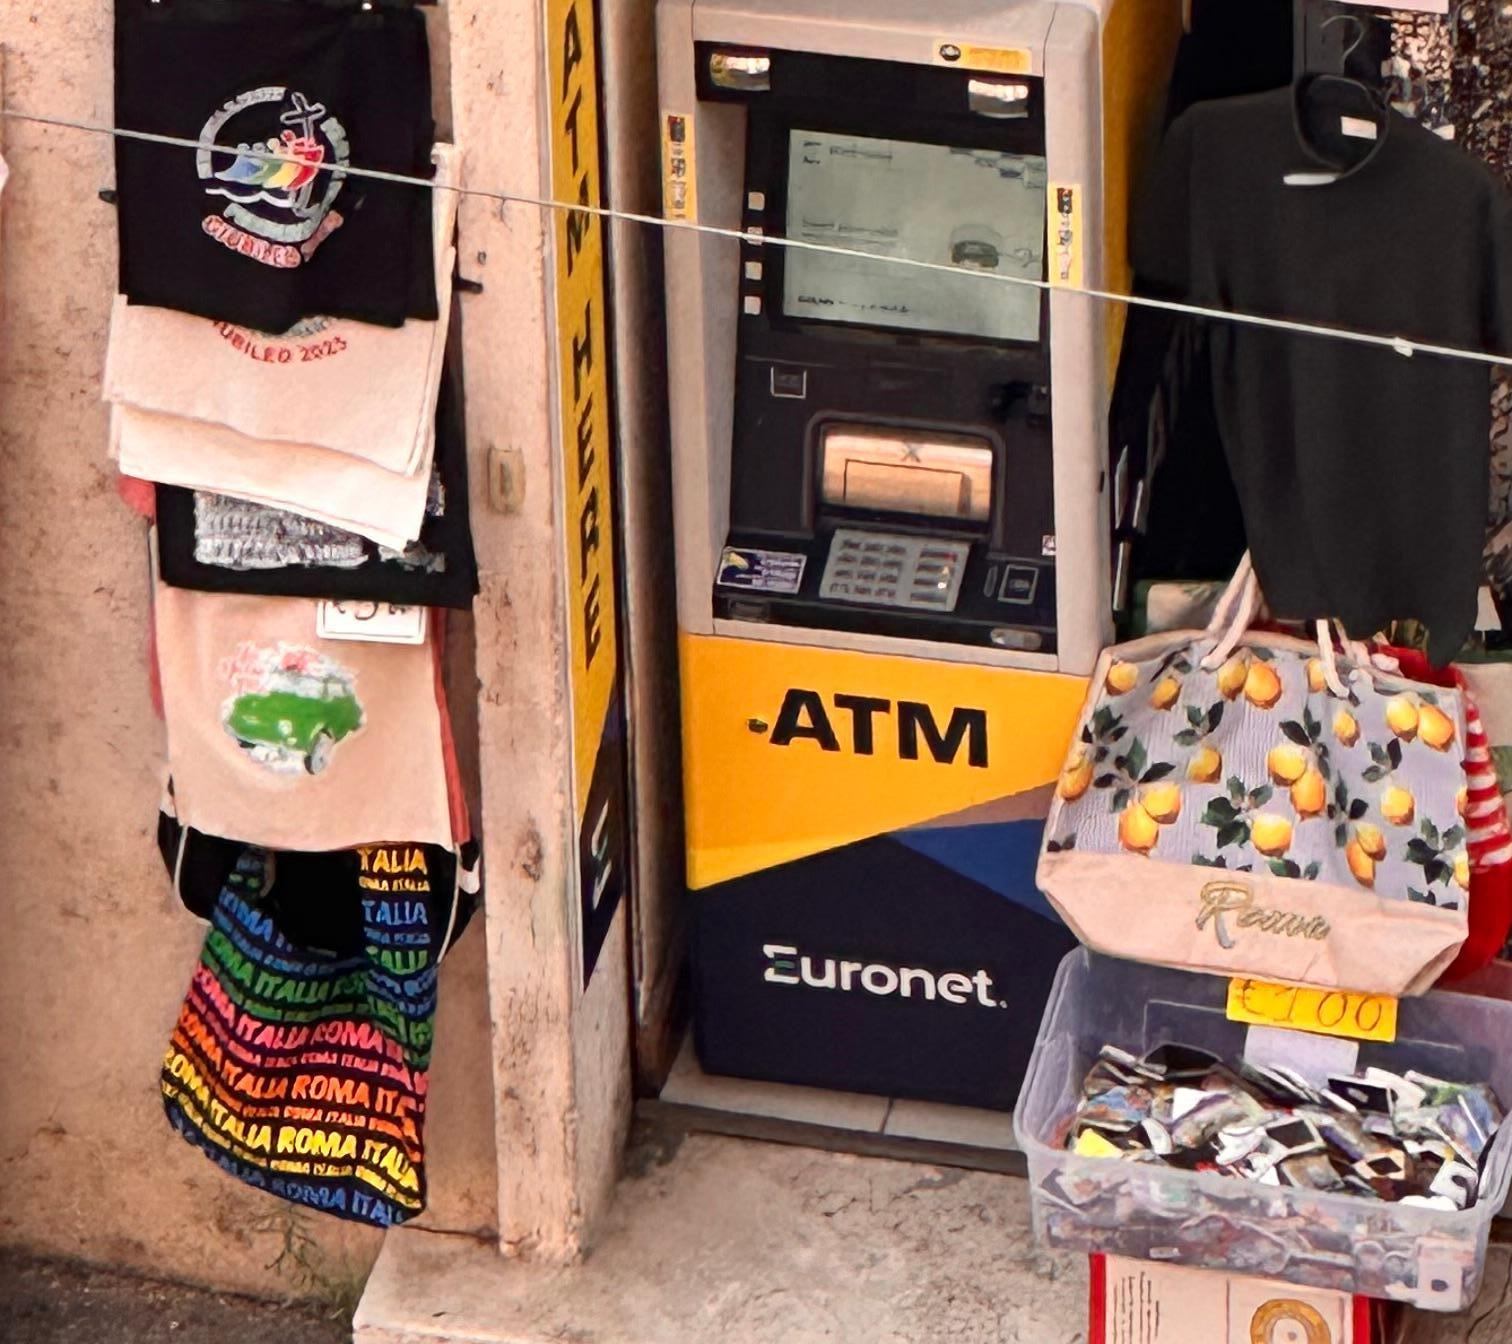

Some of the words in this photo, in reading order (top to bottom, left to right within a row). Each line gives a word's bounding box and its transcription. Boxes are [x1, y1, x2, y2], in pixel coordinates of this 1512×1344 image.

[562, 0, 590, 278] ATM
[573, 297, 602, 672] HERE
[769, 688, 988, 768] ATM
[291, 1074, 371, 1110] ROMA
[276, 1125, 358, 1161] ROMA
